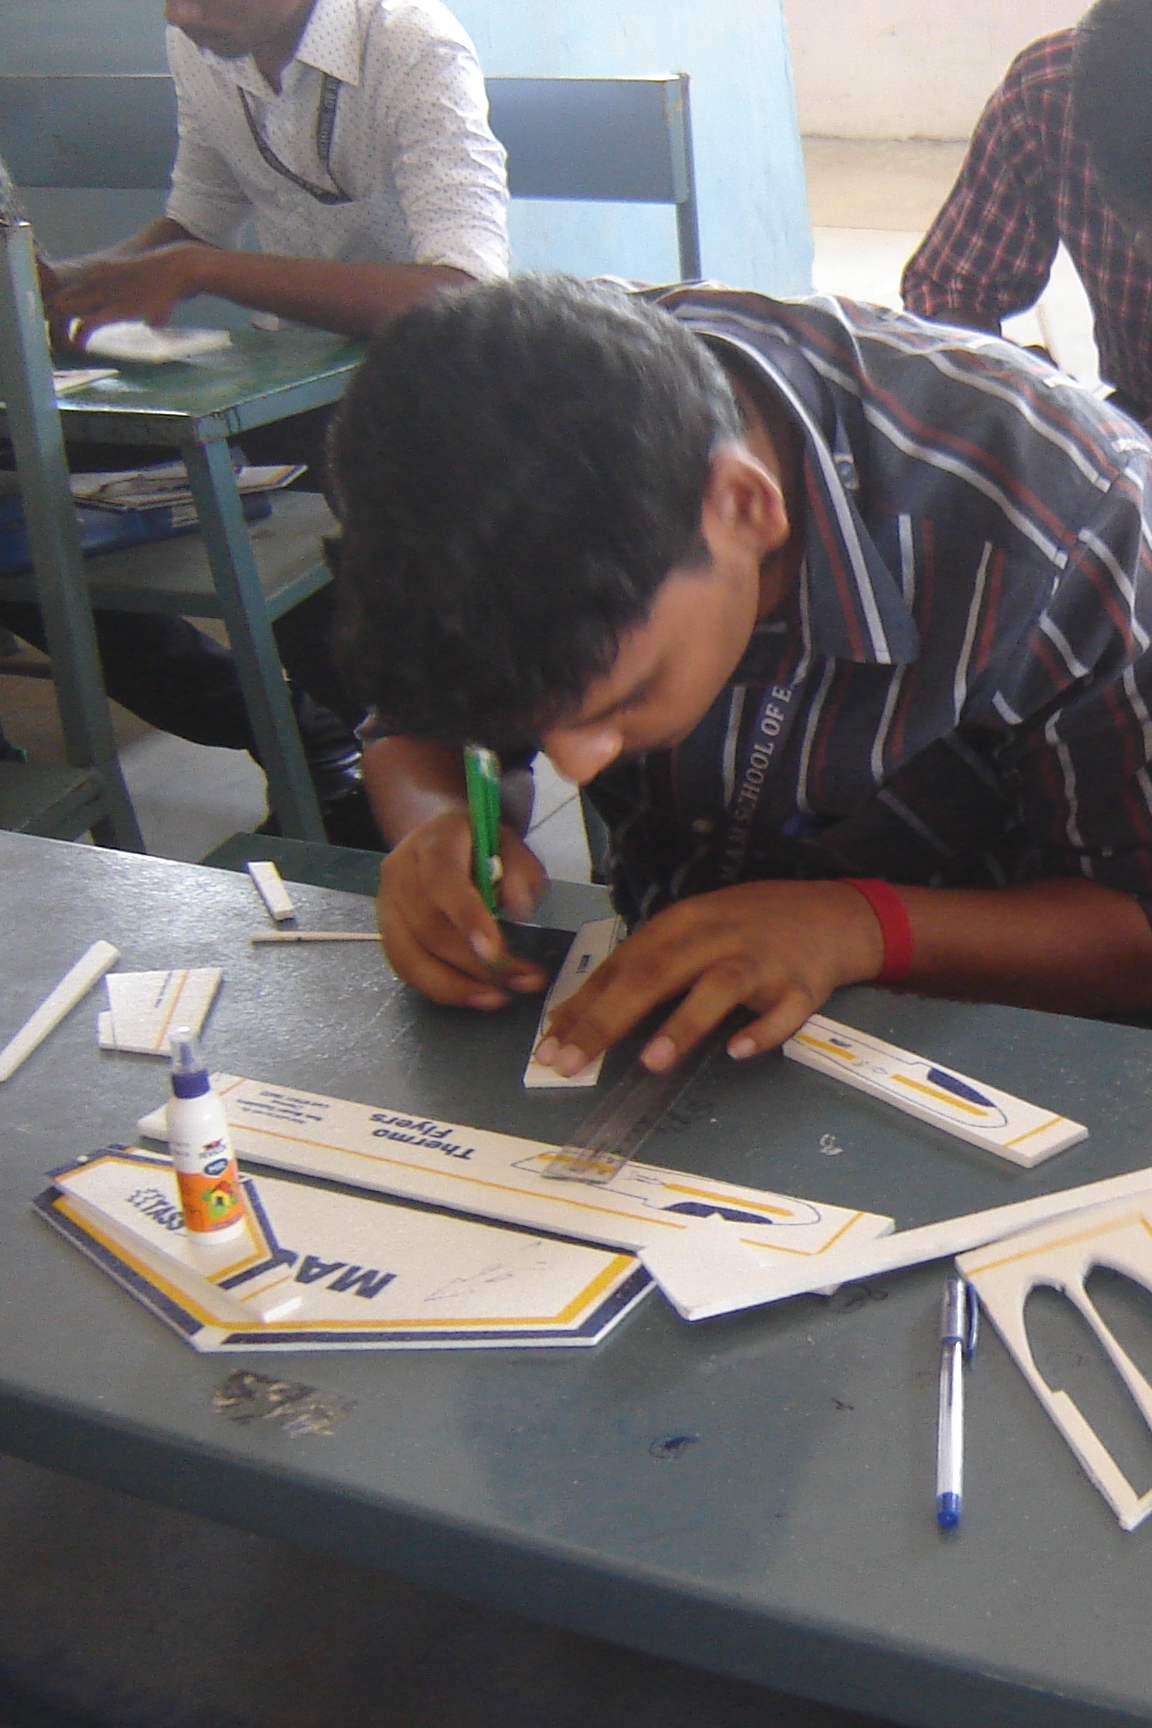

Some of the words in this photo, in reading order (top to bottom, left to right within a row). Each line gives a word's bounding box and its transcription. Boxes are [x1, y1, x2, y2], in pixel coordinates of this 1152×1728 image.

[760, 703, 787, 737] OF
[368, 1112, 455, 1139] Flyers
[370, 1127, 475, 1161] Thermo
